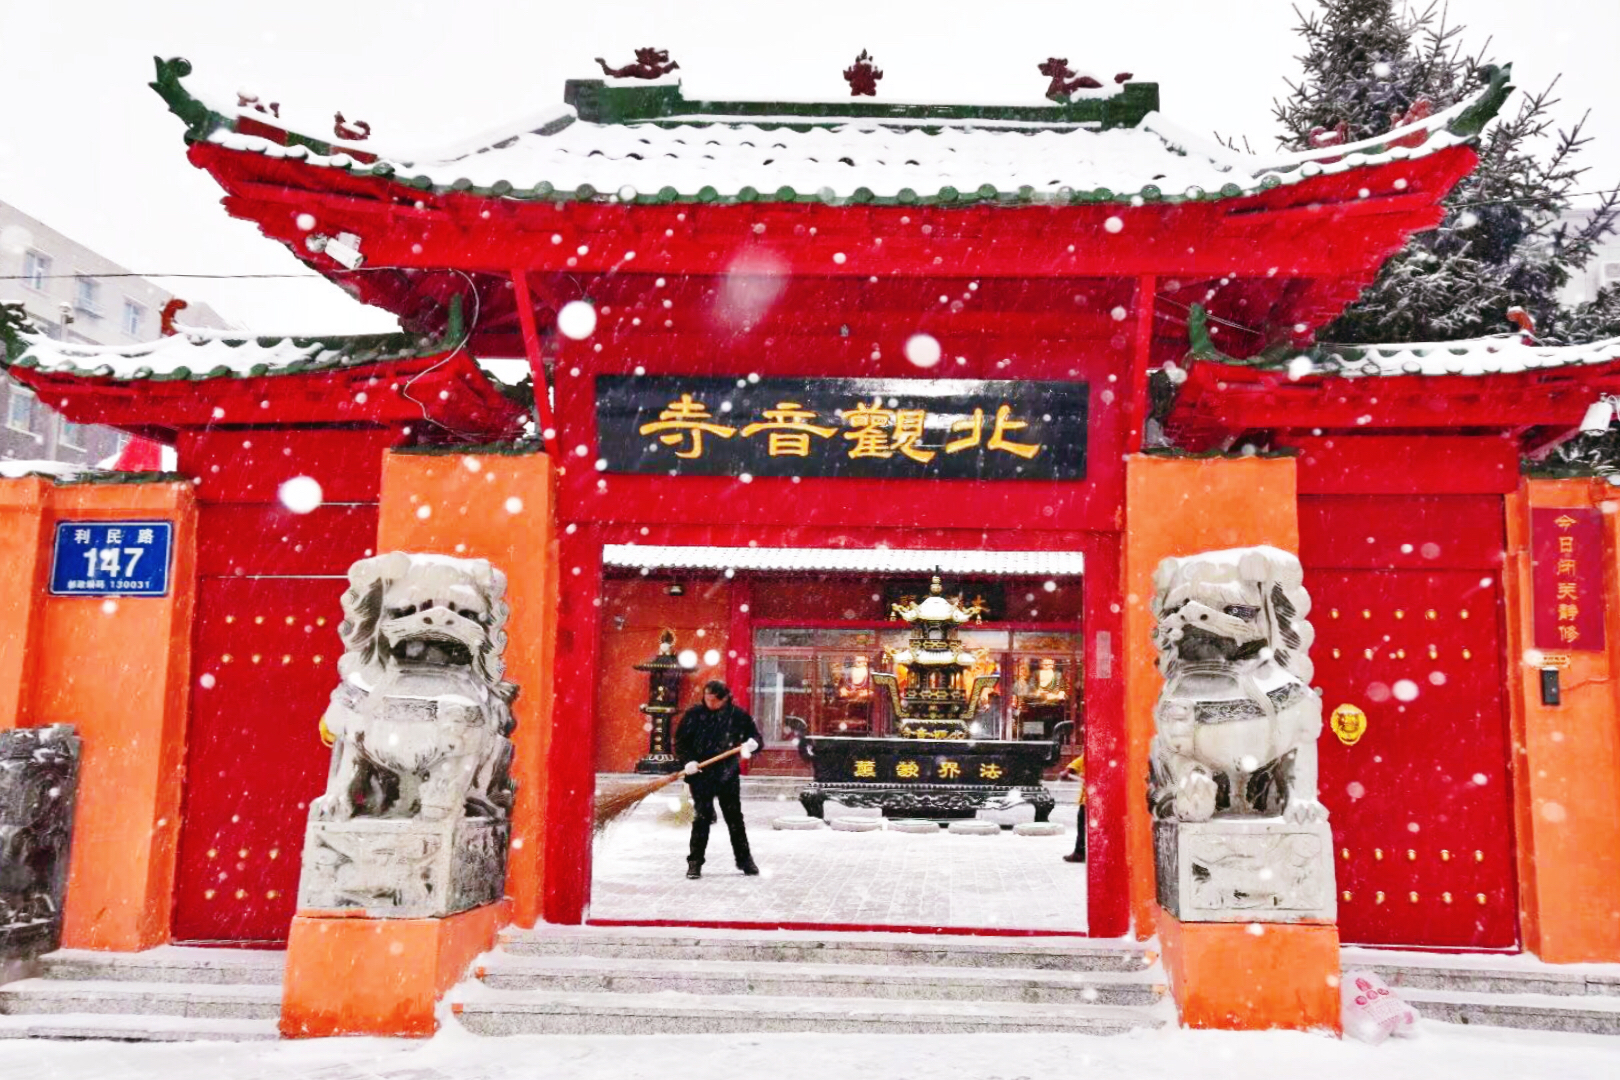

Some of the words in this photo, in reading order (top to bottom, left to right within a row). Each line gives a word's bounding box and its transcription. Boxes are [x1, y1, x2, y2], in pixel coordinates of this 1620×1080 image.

[74, 529, 154, 544] 利民路
[83, 547, 144, 577] 147
